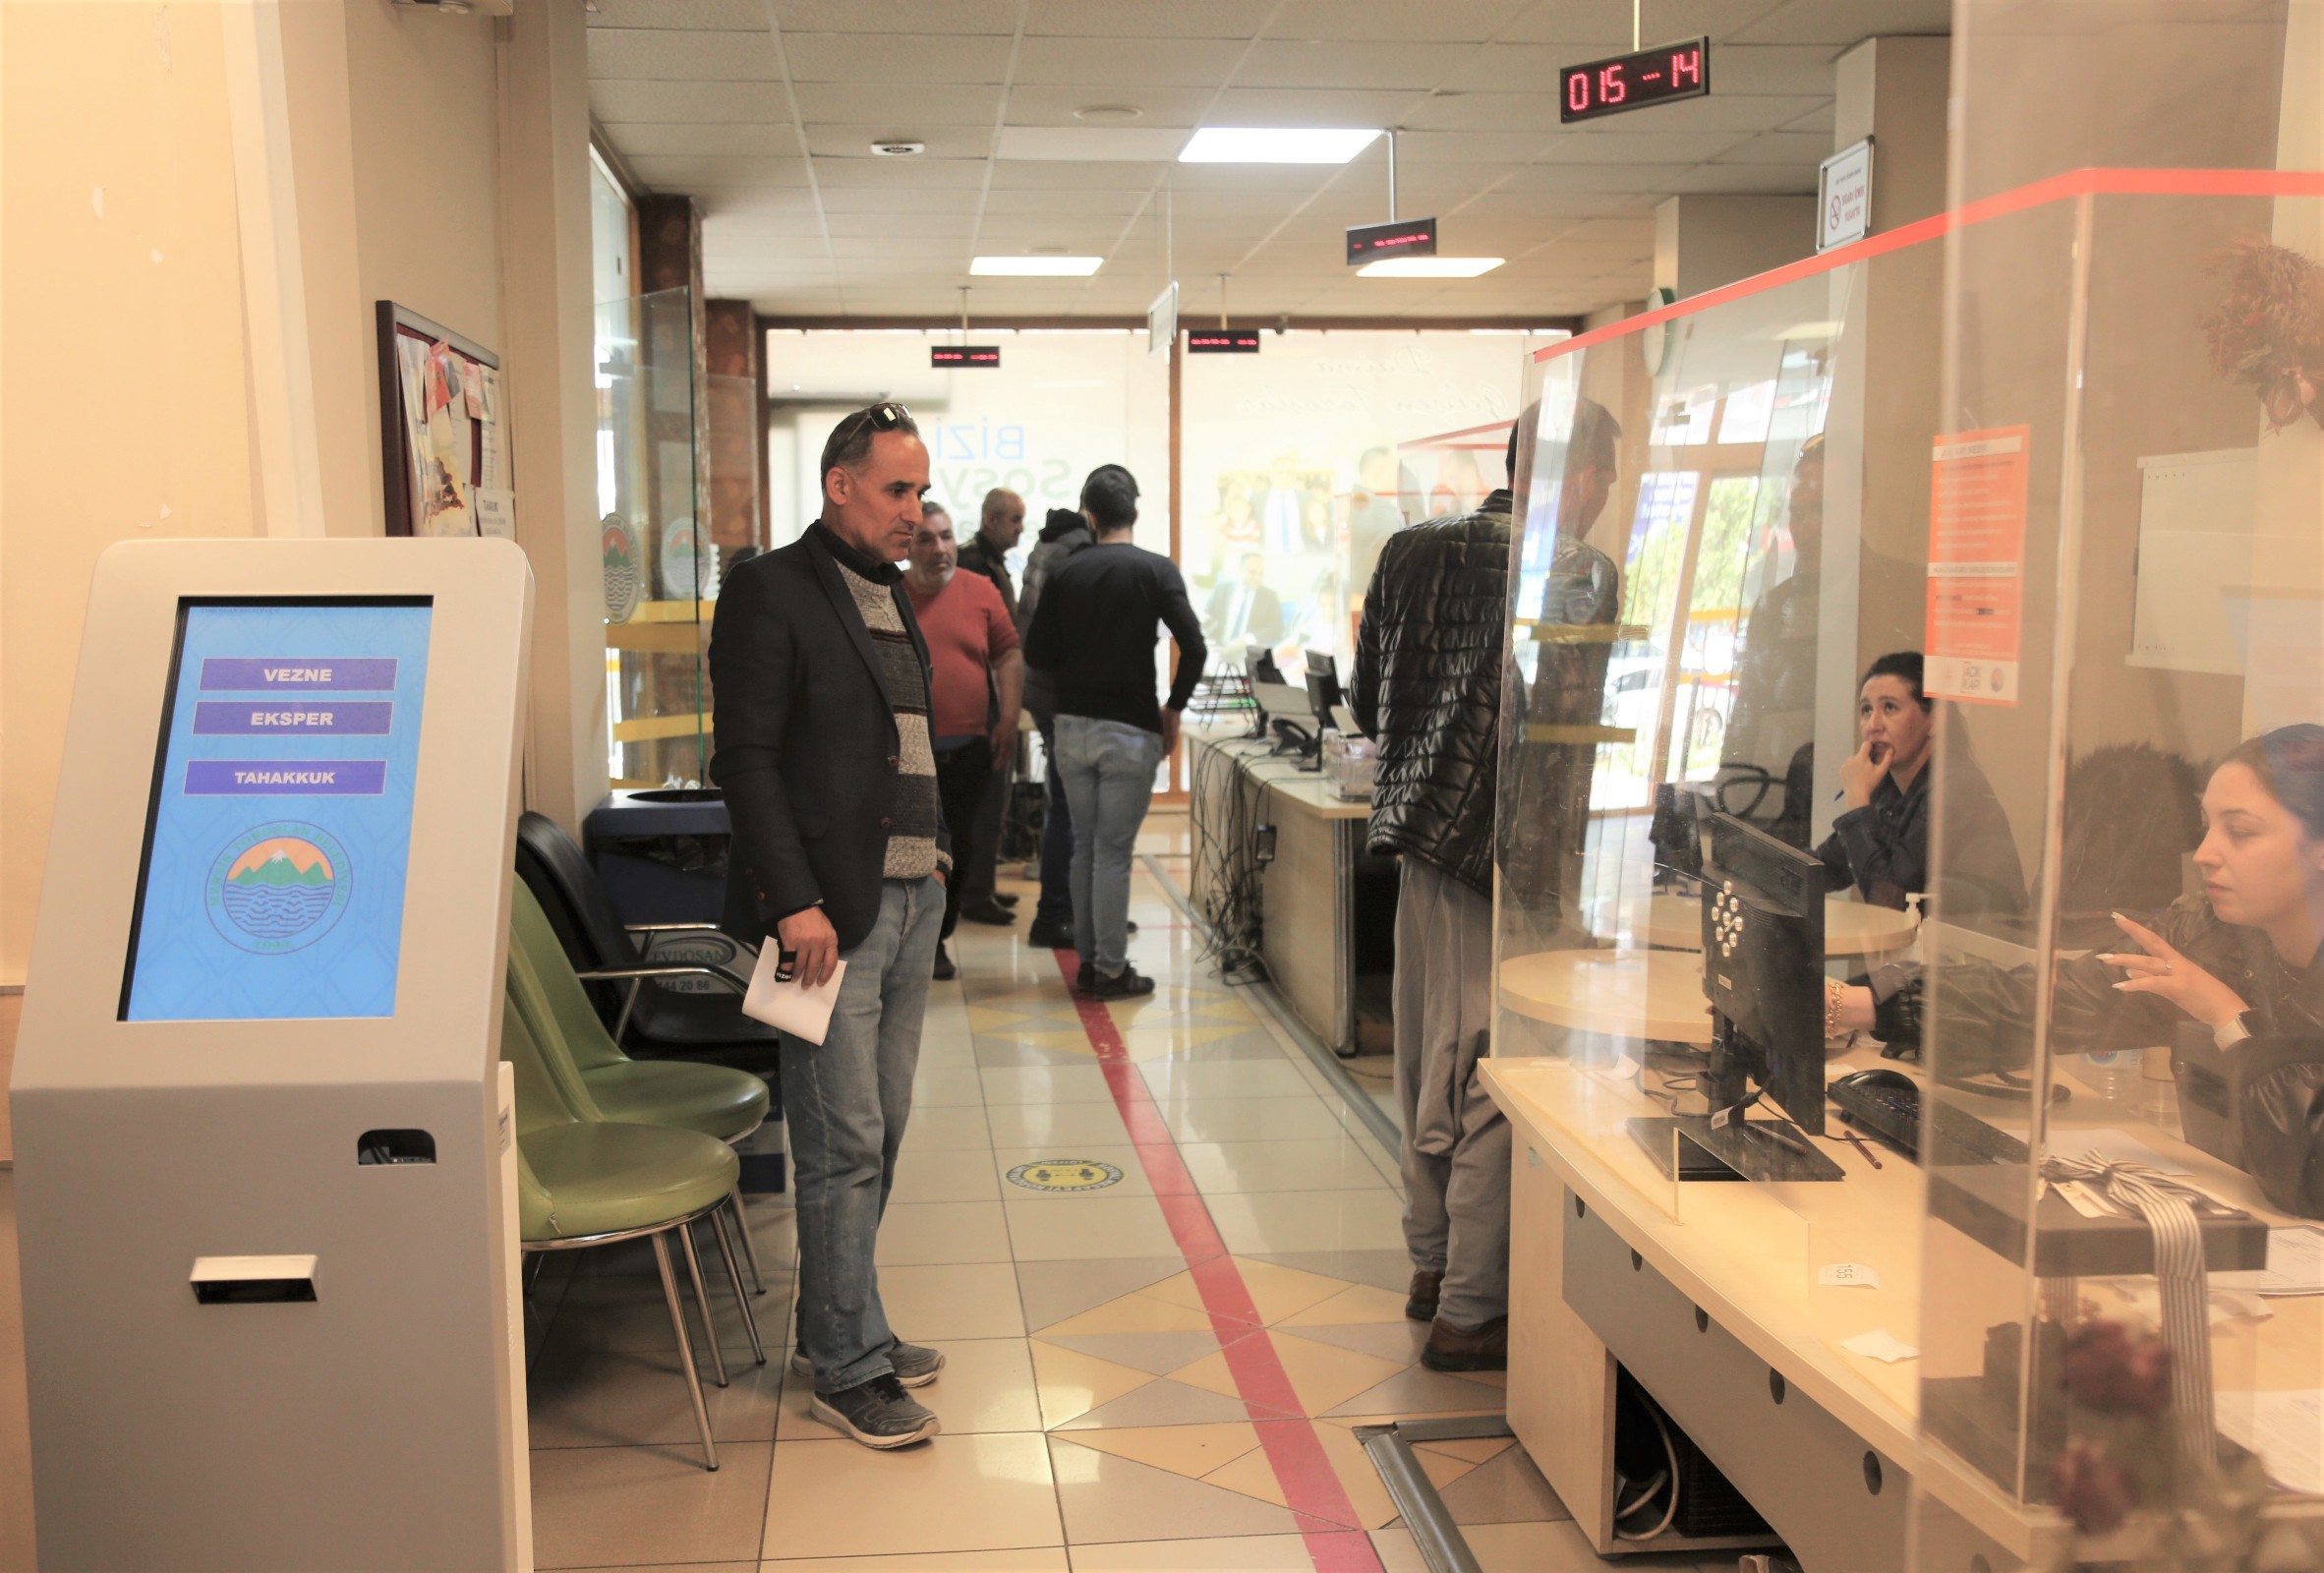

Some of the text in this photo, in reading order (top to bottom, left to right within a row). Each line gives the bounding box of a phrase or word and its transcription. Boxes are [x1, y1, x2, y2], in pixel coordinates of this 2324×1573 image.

[1671, 50, 1699, 88] 14
[263, 669, 333, 682] VEZNE
[251, 712, 334, 727] EKSPER
[234, 771, 335, 785] TAHAKKUK
[679, 980, 693, 991] 20
[1835, 1264, 1853, 1279] 155
